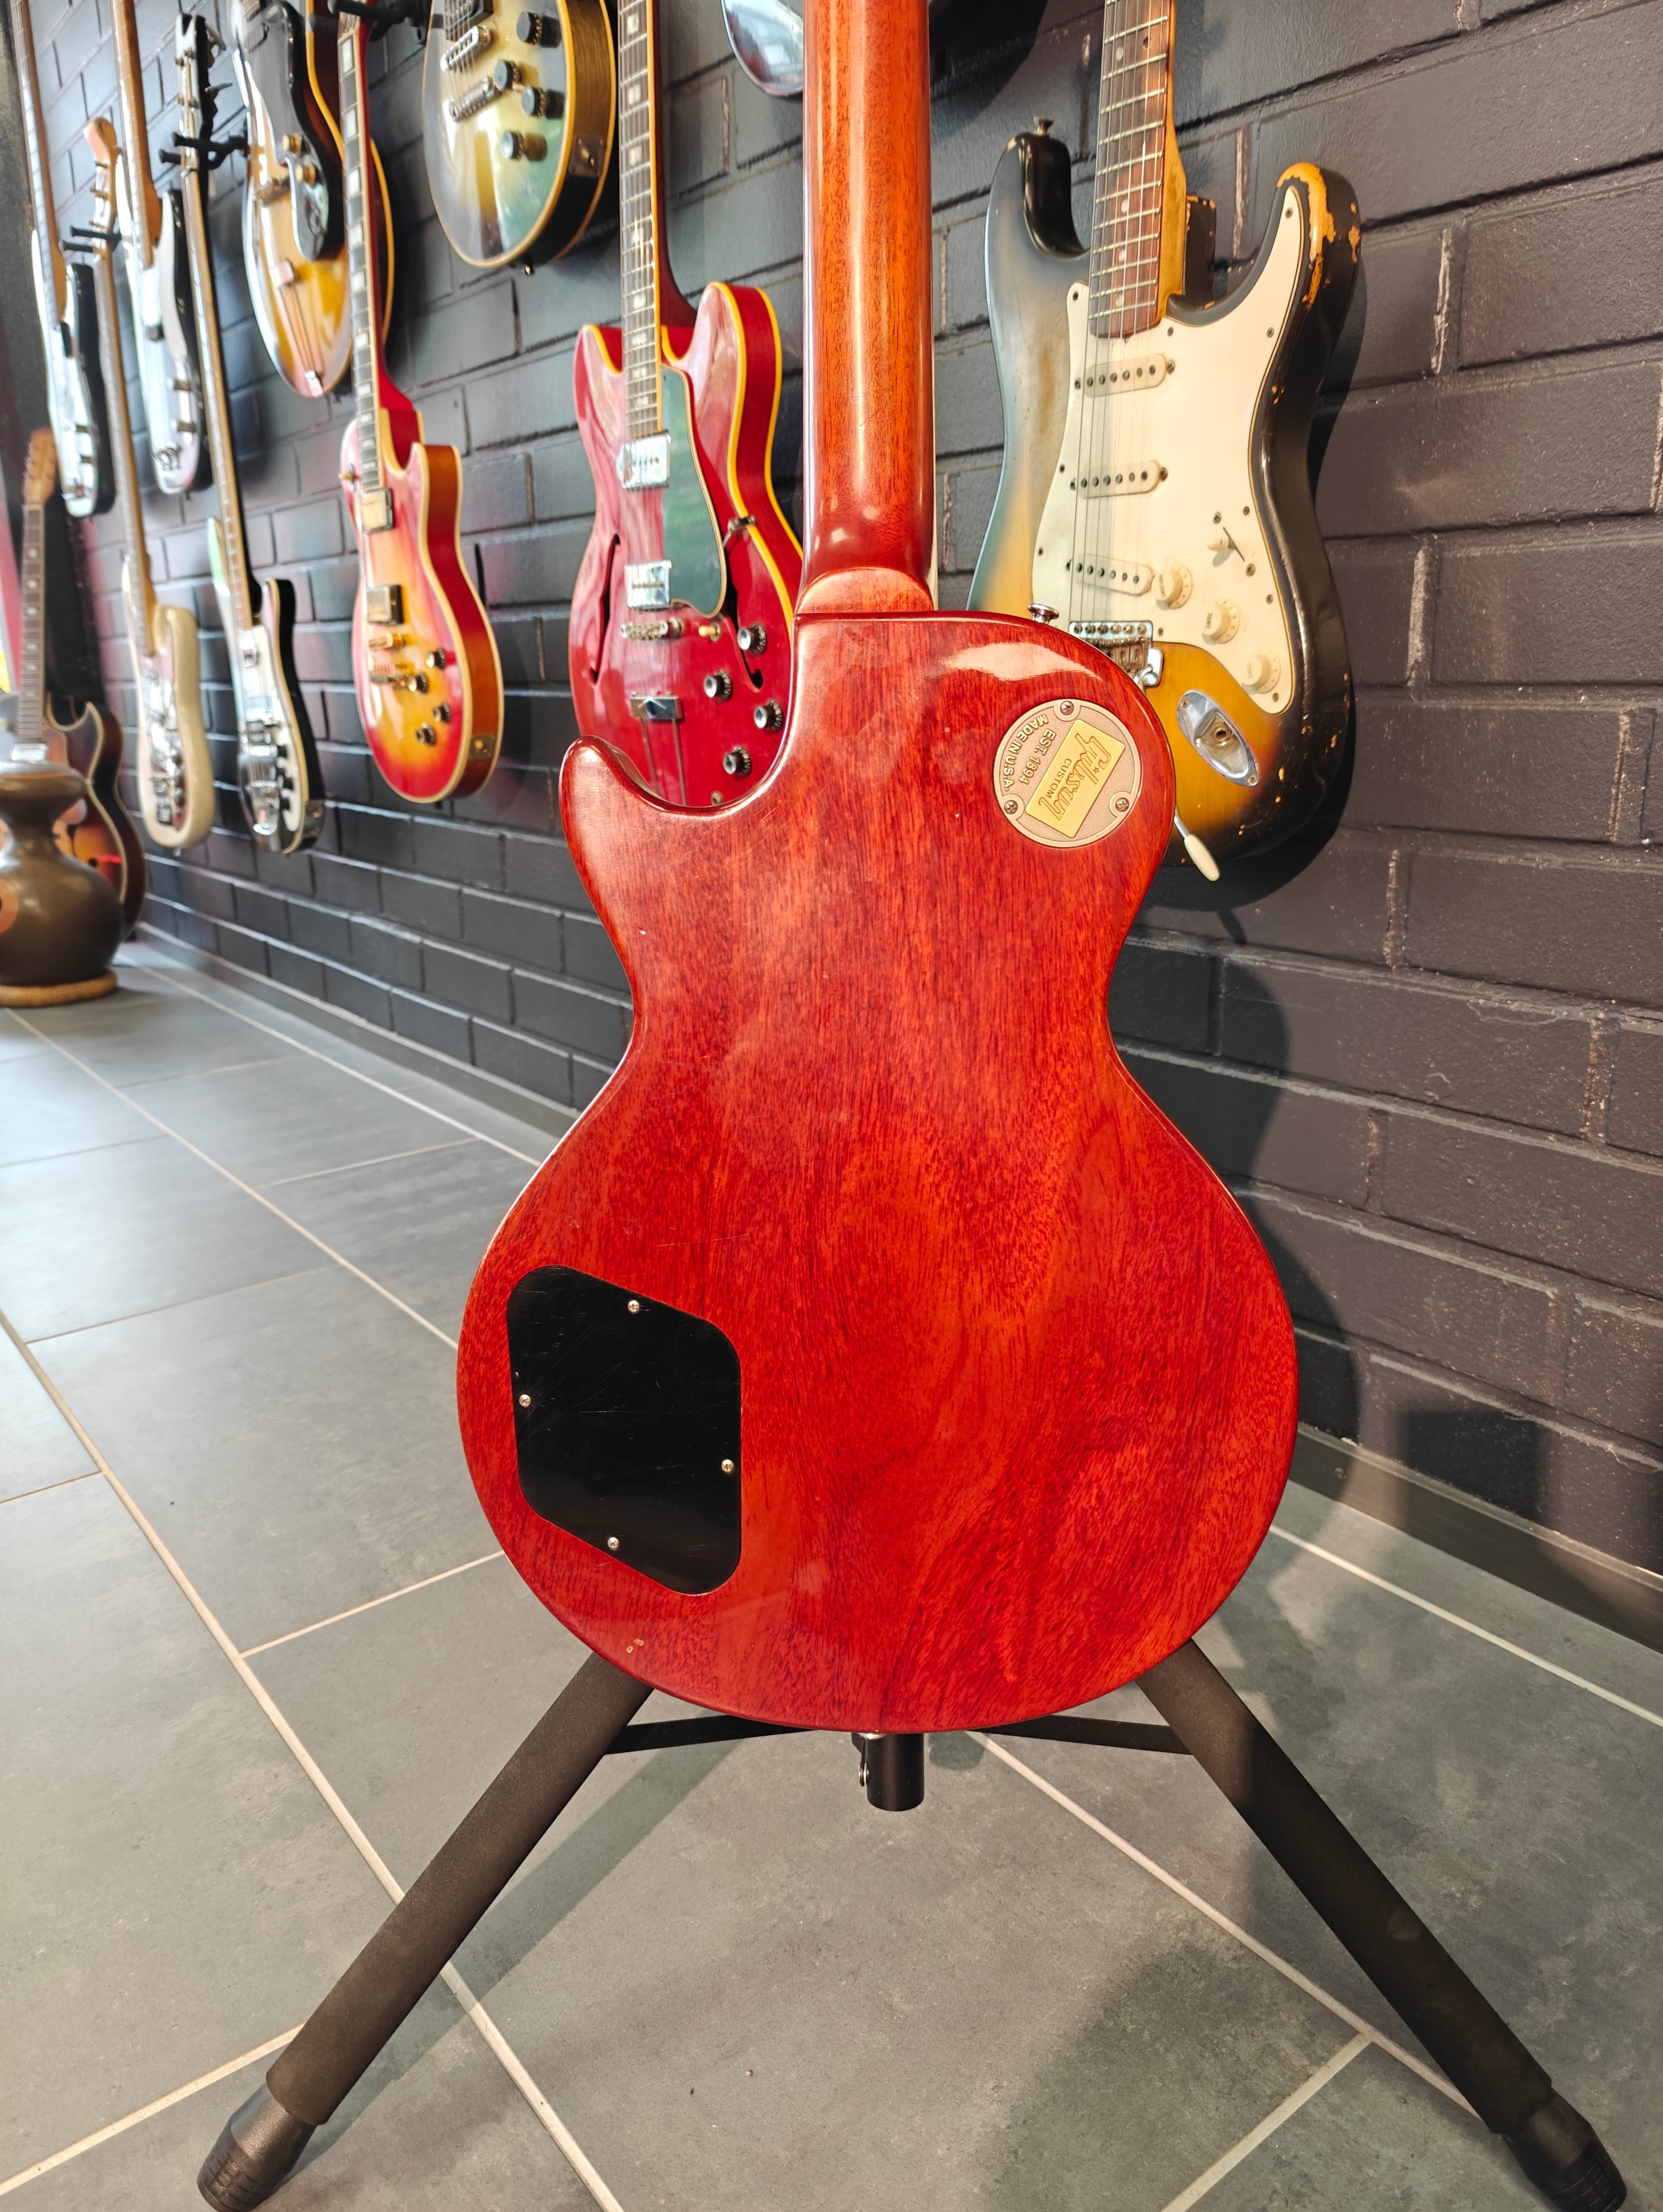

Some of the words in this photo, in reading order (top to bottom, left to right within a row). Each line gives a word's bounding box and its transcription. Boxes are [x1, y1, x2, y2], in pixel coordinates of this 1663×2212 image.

[1016, 714, 1049, 742] MADE
[1034, 728, 1057, 756] EST.
[1008, 740, 1022, 754] IN
[1003, 755, 1016, 791] U.S.A.
[1018, 757, 1041, 785] 1894
[1038, 733, 1112, 821] Gibson
[1045, 758, 1072, 799] CUSTOM
